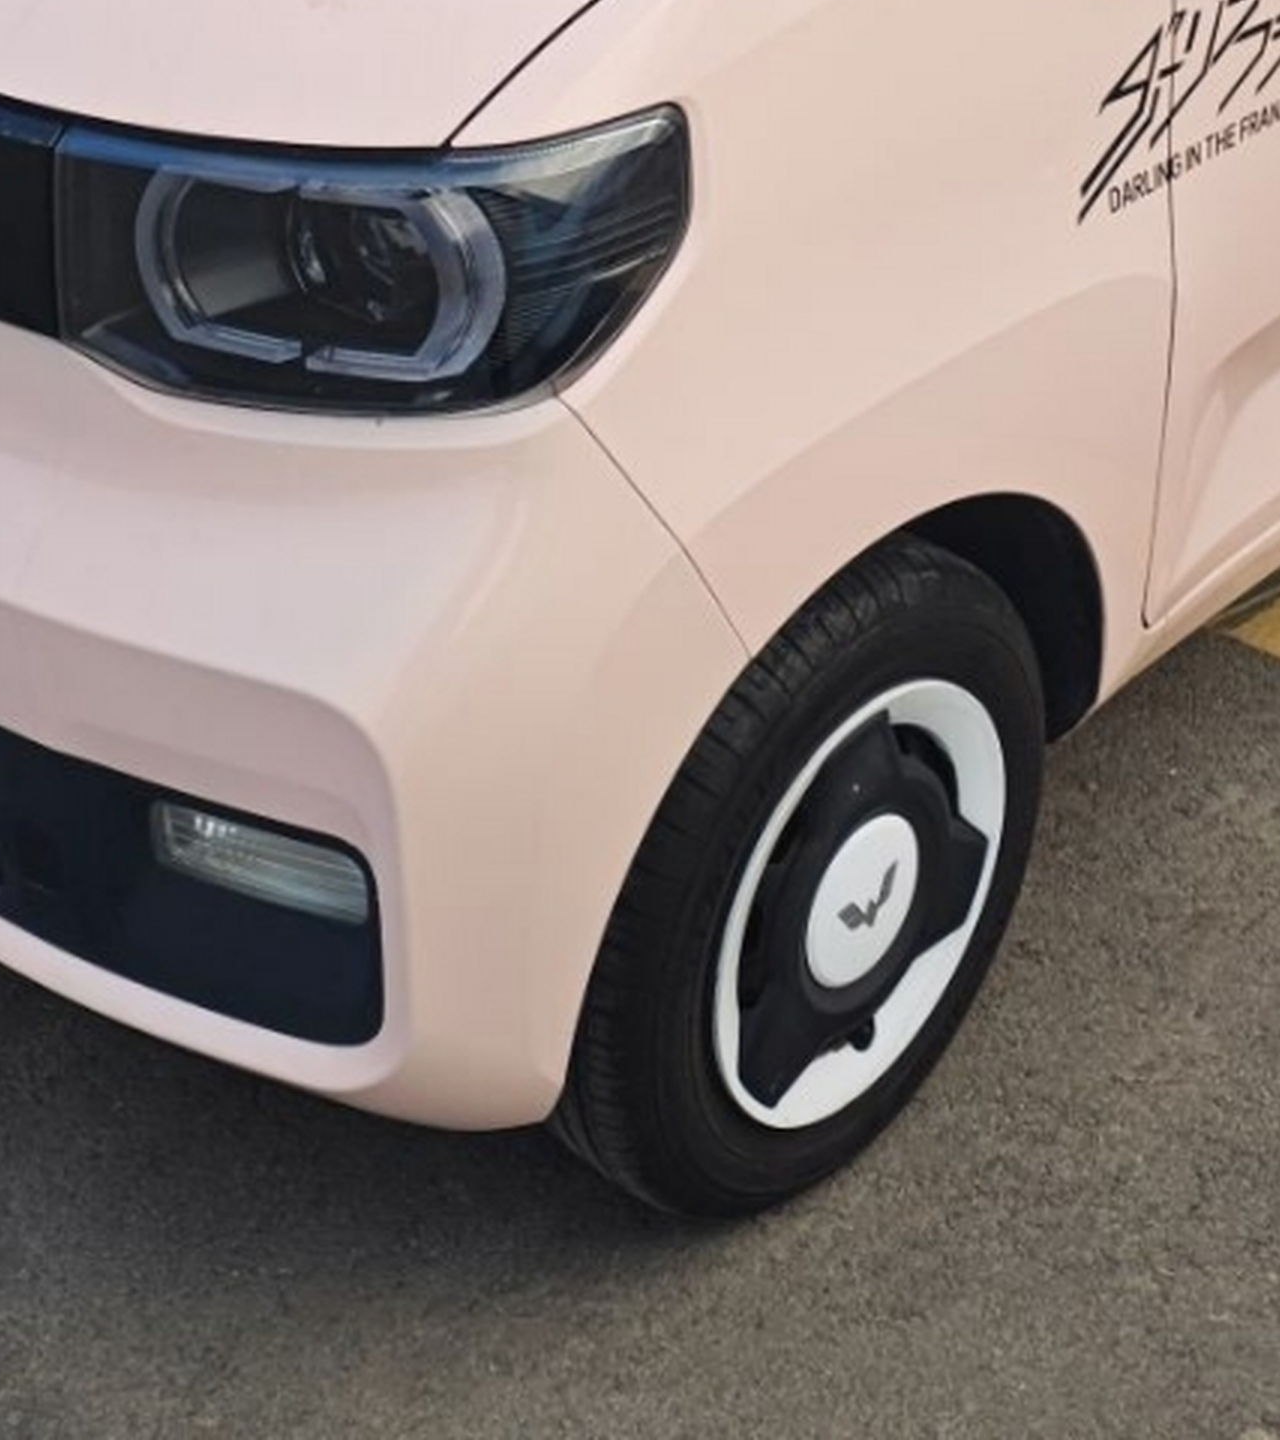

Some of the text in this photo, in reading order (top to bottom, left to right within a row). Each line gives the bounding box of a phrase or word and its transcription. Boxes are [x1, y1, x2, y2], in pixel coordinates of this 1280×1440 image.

[1107, 152, 1183, 214] DARLING
[1185, 139, 1202, 171] IN
[1204, 121, 1238, 160] THE
